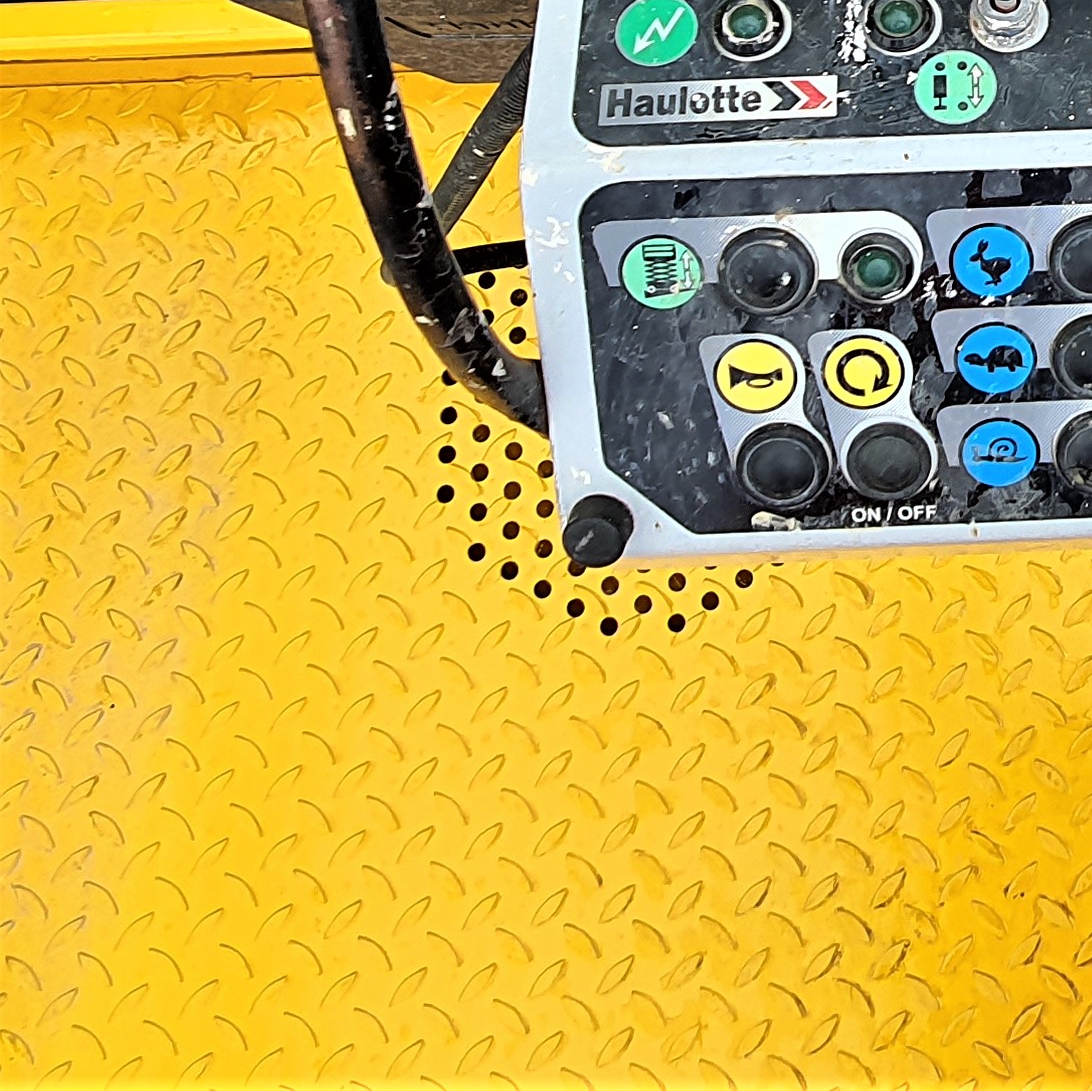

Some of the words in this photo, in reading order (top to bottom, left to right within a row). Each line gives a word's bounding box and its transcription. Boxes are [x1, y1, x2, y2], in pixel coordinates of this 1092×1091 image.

[606, 85, 762, 118] Haulotte
[851, 506, 881, 523] ON
[897, 504, 937, 521] OFF
